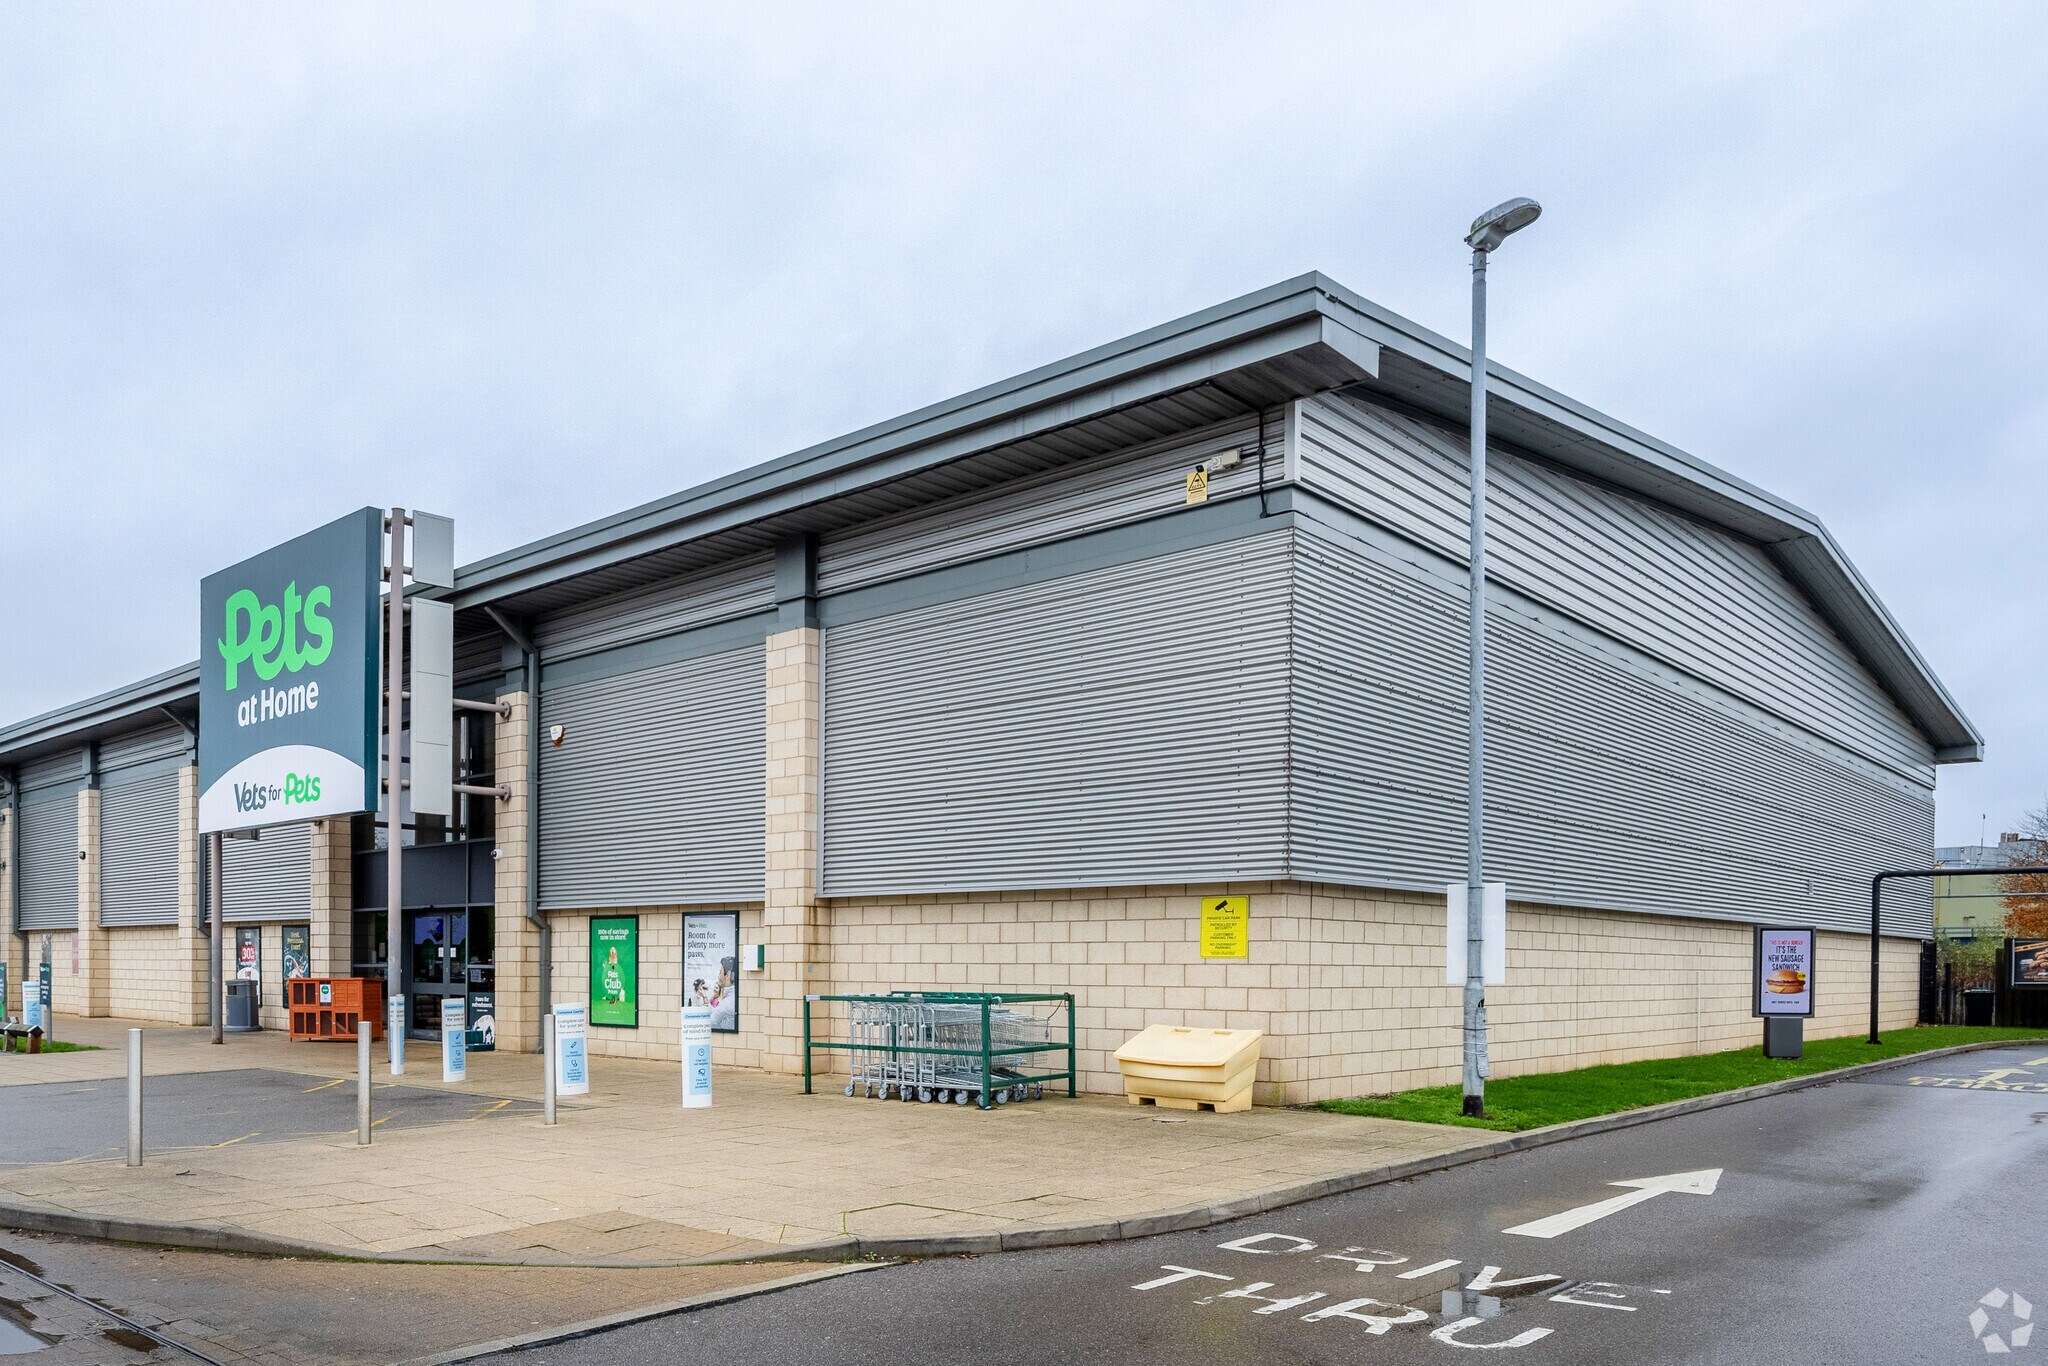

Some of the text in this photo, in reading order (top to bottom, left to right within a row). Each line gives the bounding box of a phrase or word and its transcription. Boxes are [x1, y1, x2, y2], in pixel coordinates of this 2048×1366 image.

[218, 580, 334, 691] Pets
[238, 681, 320, 726] at Home
[234, 773, 321, 813] Vets for Pets
[688, 931, 716, 939] Room for
[688, 940, 707, 950] plenty
[1776, 946, 1797, 954] IT'S THE
[688, 951, 704, 960] paws.
[1768, 954, 1804, 963] NEW SAUSAGE
[604, 978, 622, 989] Club
[1215, 1231, 1672, 1312] DRIVE
[1130, 1264, 1555, 1349] THRU
